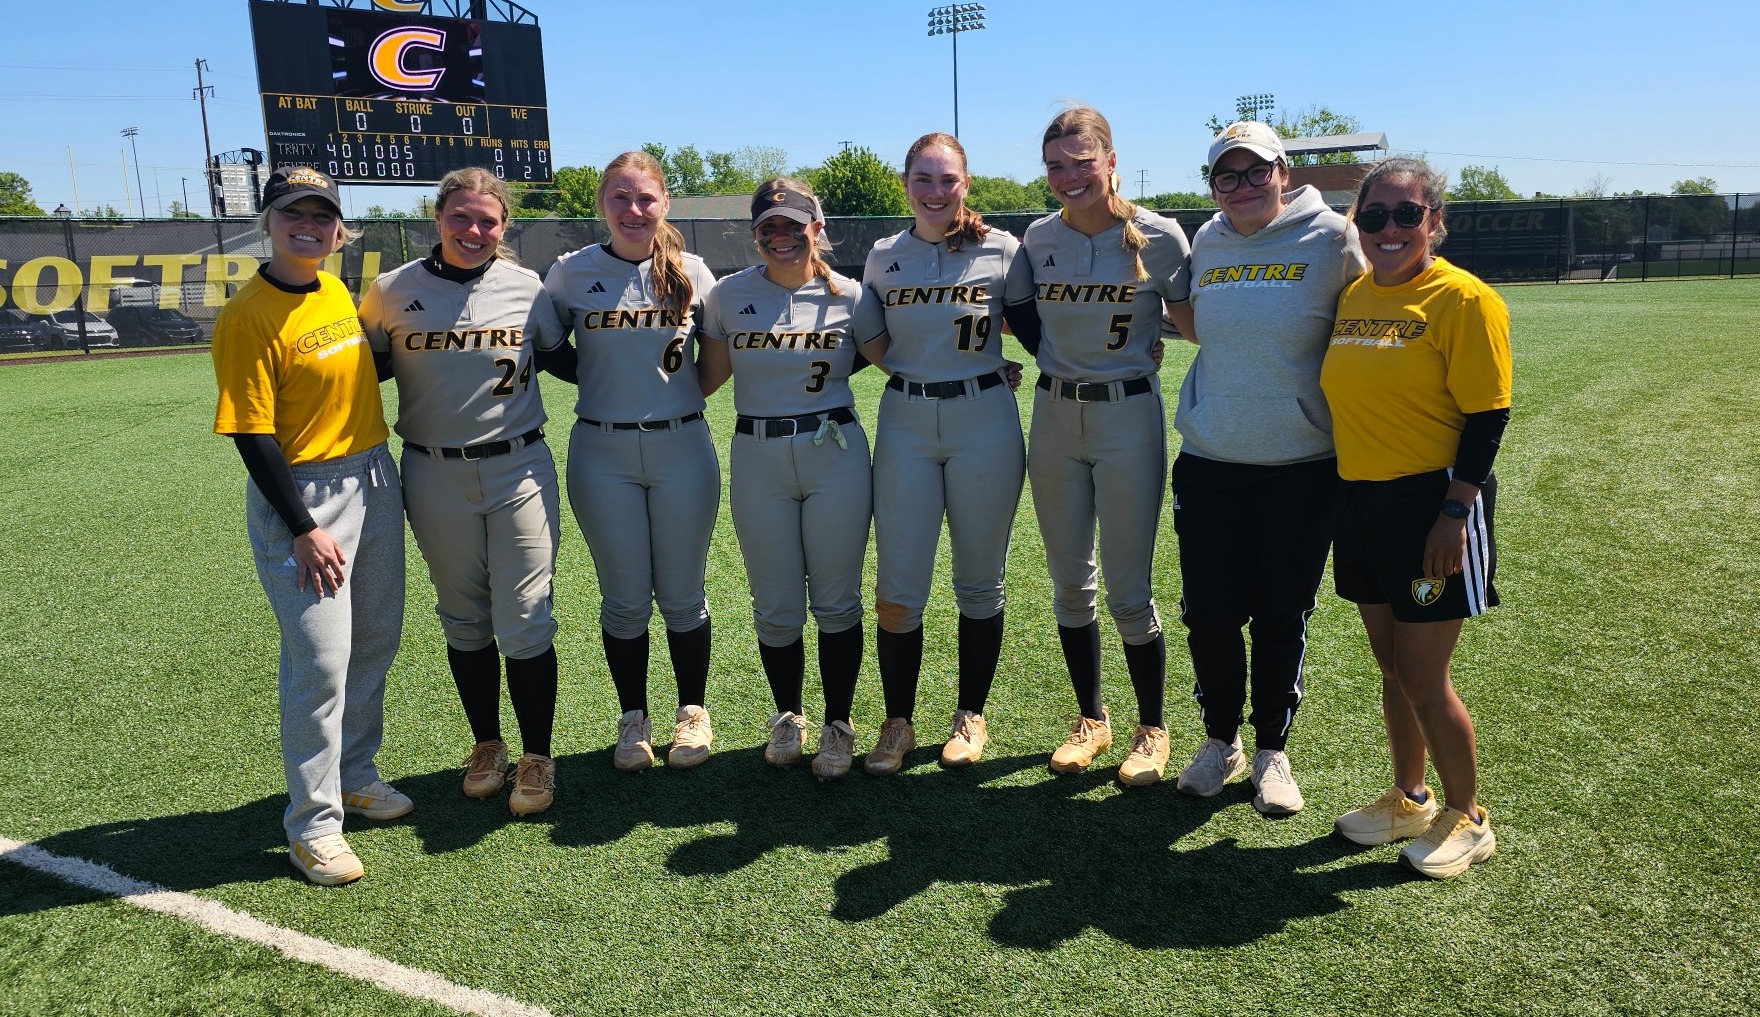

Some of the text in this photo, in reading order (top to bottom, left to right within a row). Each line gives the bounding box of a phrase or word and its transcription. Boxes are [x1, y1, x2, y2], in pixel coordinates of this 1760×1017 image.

[368, 26, 446, 91] C
[278, 96, 318, 110] AT BAT
[345, 100, 373, 112] BALL
[395, 102, 433, 115] STRIKE
[456, 106, 476, 117] OUT
[356, 112, 367, 131] 0
[410, 115, 421, 133] 0
[511, 108, 528, 120] H/E
[462, 117, 473, 135] 0
[276, 143, 315, 156] TRNTY
[328, 133, 550, 149] 1 2 3 4 5 6 7 8 9 10 RUNS HITS ERR
[771, 192, 786, 203] C
[1447, 211, 1545, 233] OCCER
[1199, 263, 1309, 287] CENTRE
[1036, 283, 1138, 305] CENTRE
[1203, 280, 1293, 291] SOFTBALL
[885, 285, 988, 308] CENTRE
[584, 308, 688, 330] CENTRE
[1332, 319, 1428, 339] CENTRE
[404, 327, 524, 351] CENTRE
[732, 330, 839, 351] CENTRE
[952, 313, 992, 353] 19
[1105, 312, 1134, 352] 5
[1331, 337, 1406, 348] SOFTBALL
[662, 337, 684, 375] 6
[491, 355, 533, 397] 24
[804, 360, 832, 395] 3
